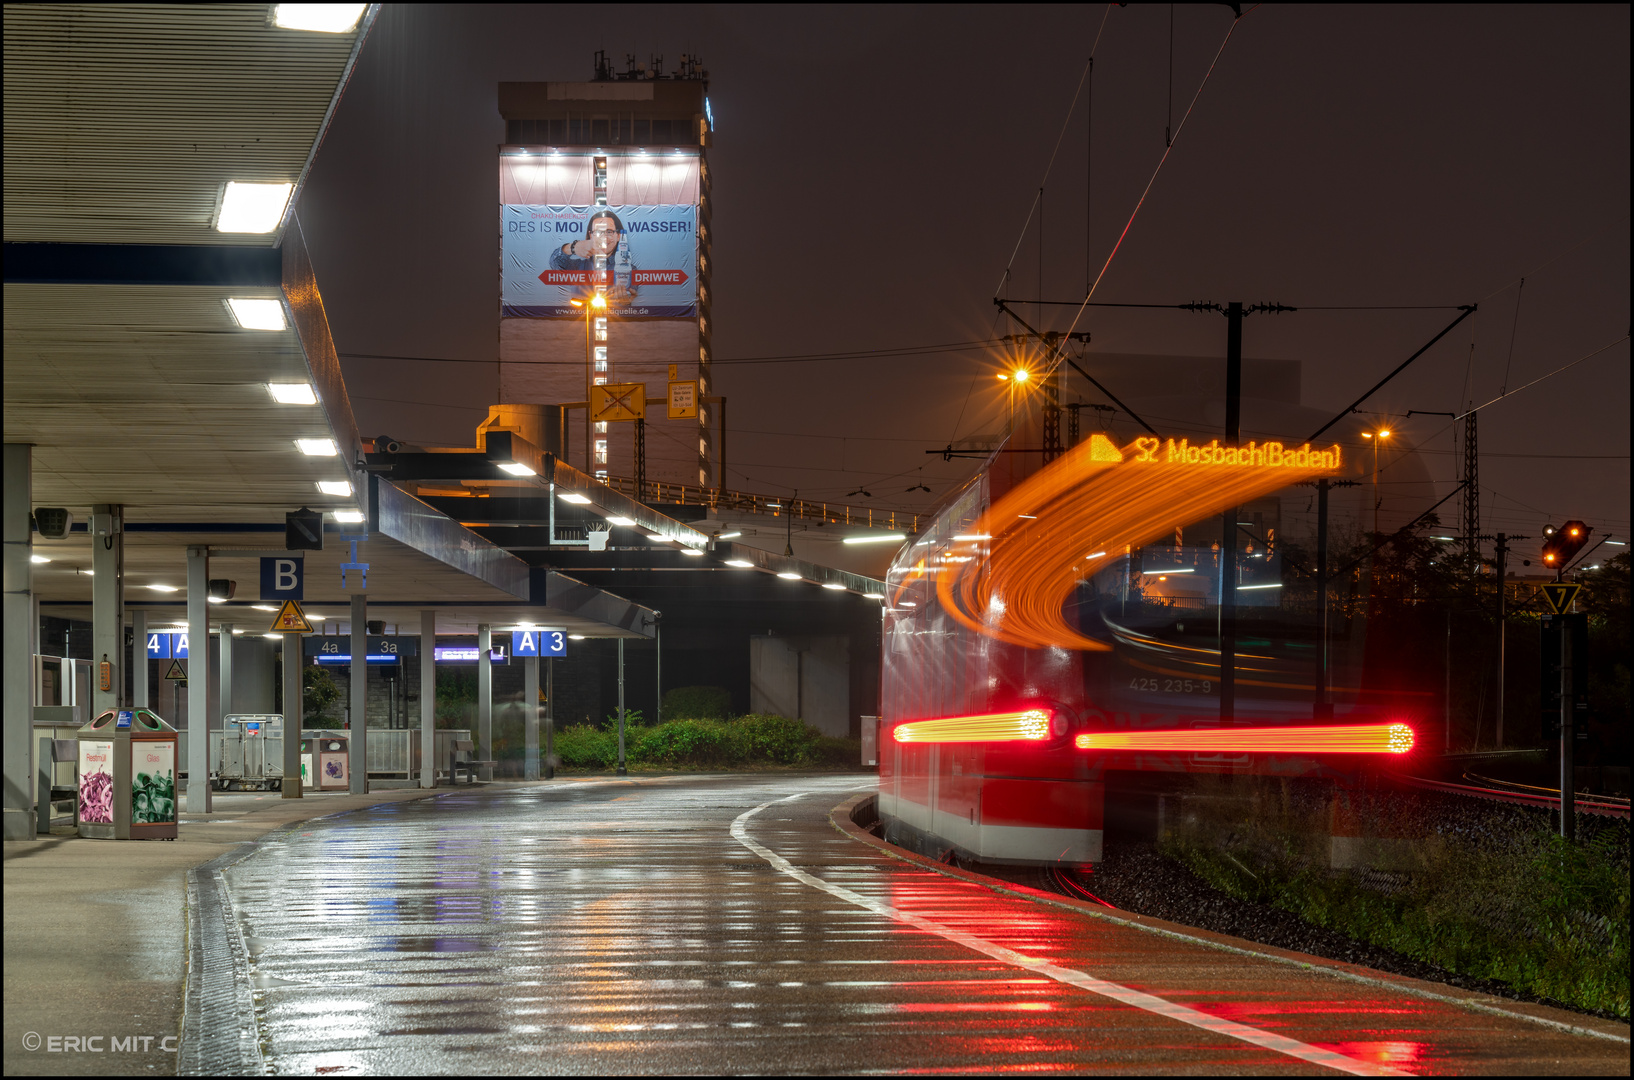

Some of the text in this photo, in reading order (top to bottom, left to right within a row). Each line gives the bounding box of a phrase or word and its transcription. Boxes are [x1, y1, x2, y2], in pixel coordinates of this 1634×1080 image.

[509, 221, 691, 233] DES IS MOI WASSER!
[548, 273, 586, 283] HIWWE
[588, 274, 607, 283] WIE
[635, 273, 680, 282] DRIWWE
[1136, 437, 1159, 462] S2
[275, 559, 298, 591] B
[1556, 588, 1567, 608] 7
[147, 634, 188, 653] 4 A
[321, 641, 397, 653] 4a 3a
[519, 632, 564, 651] A 3
[1130, 678, 1211, 693] 425 235-9
[86, 753, 107, 763] Restmüll
[146, 753, 160, 763] Glas
